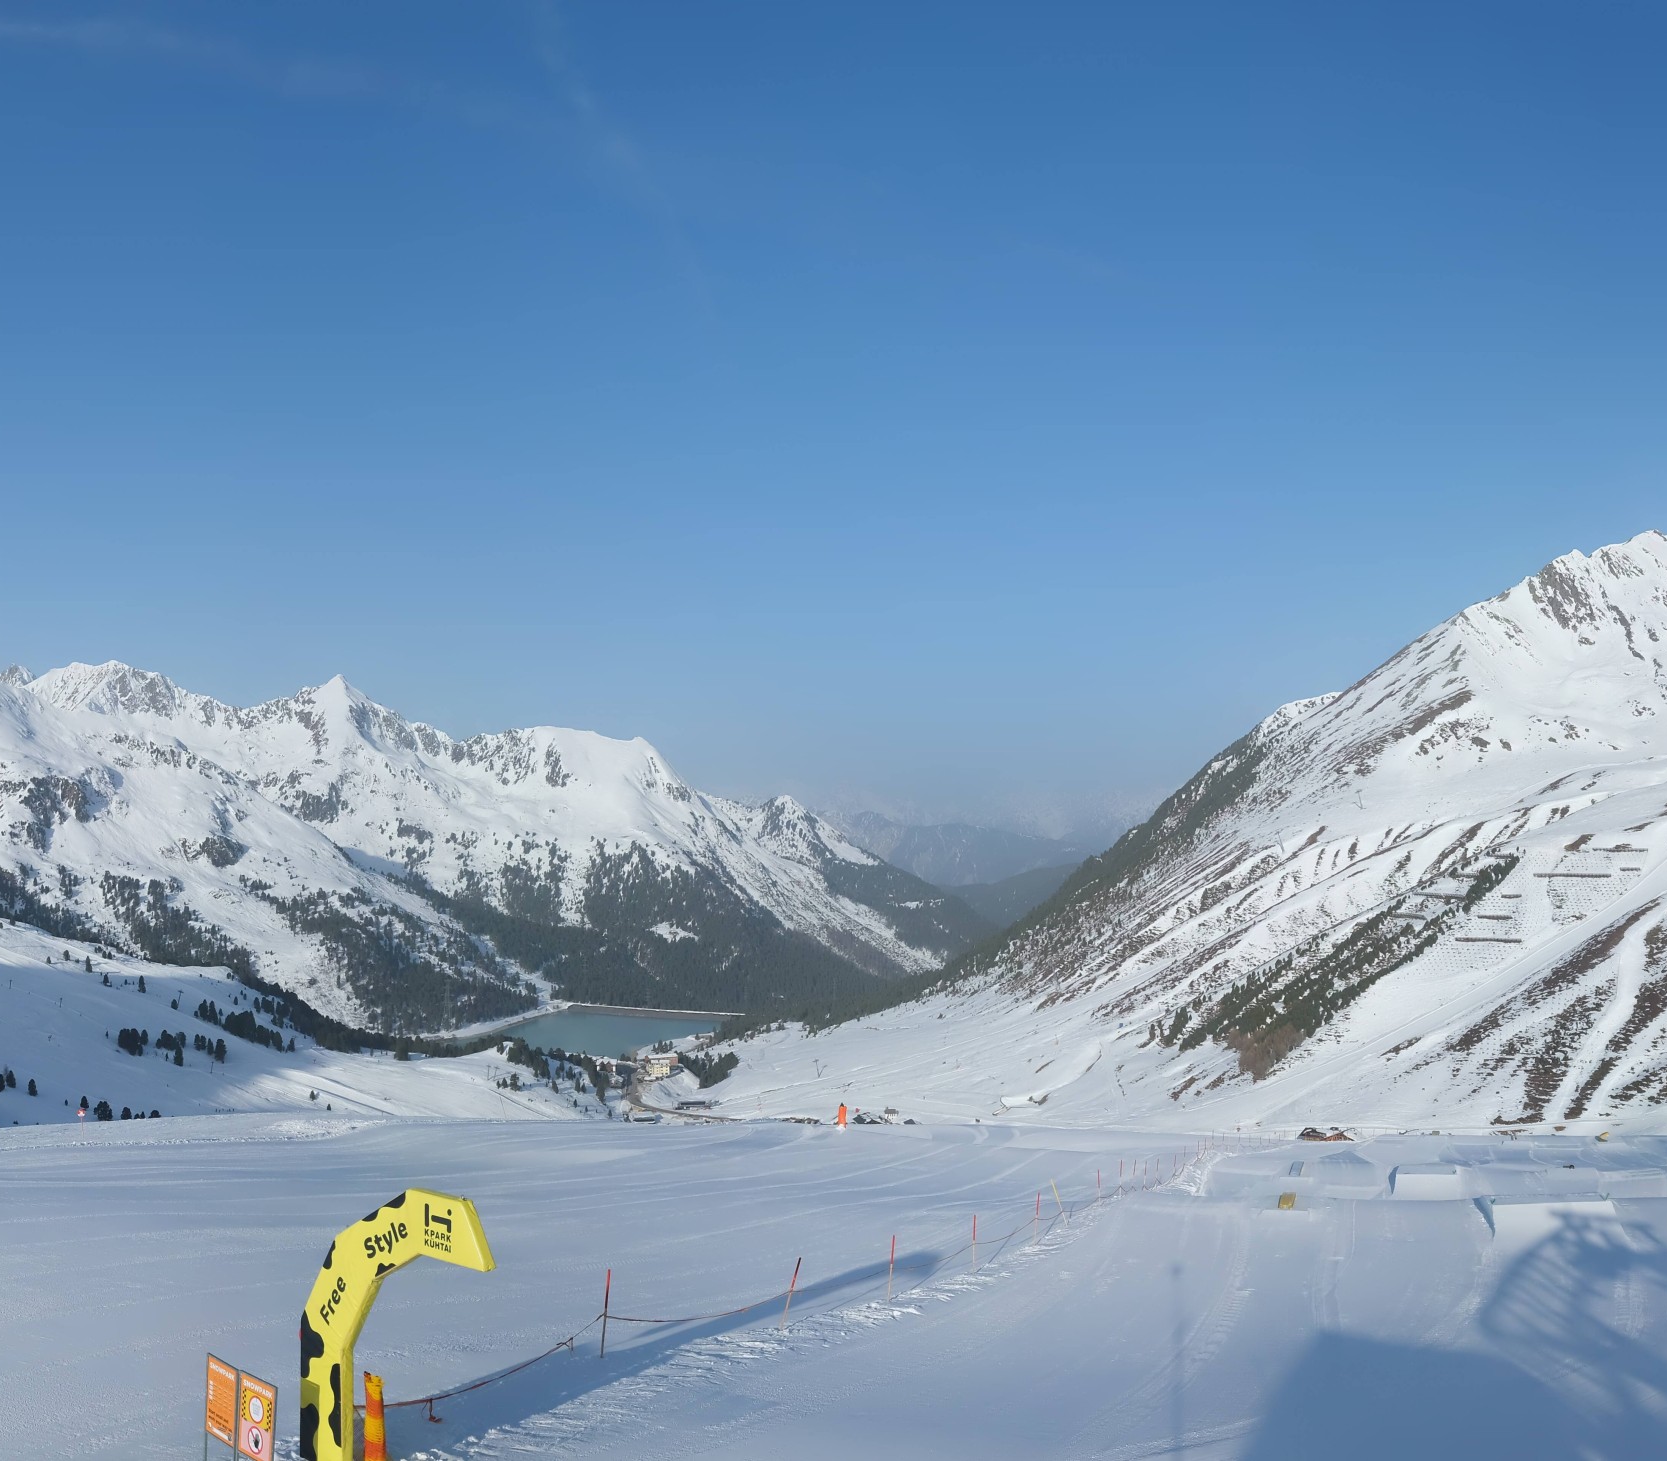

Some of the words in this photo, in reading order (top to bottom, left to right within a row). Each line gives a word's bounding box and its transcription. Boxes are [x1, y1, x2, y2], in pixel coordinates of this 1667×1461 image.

[424, 1229, 451, 1243] KPARK
[320, 1277, 346, 1326] Free
[364, 1222, 408, 1259] Style
[209, 1362, 235, 1381] SNOWPARK
[243, 1379, 273, 1399] SNOWPARK
